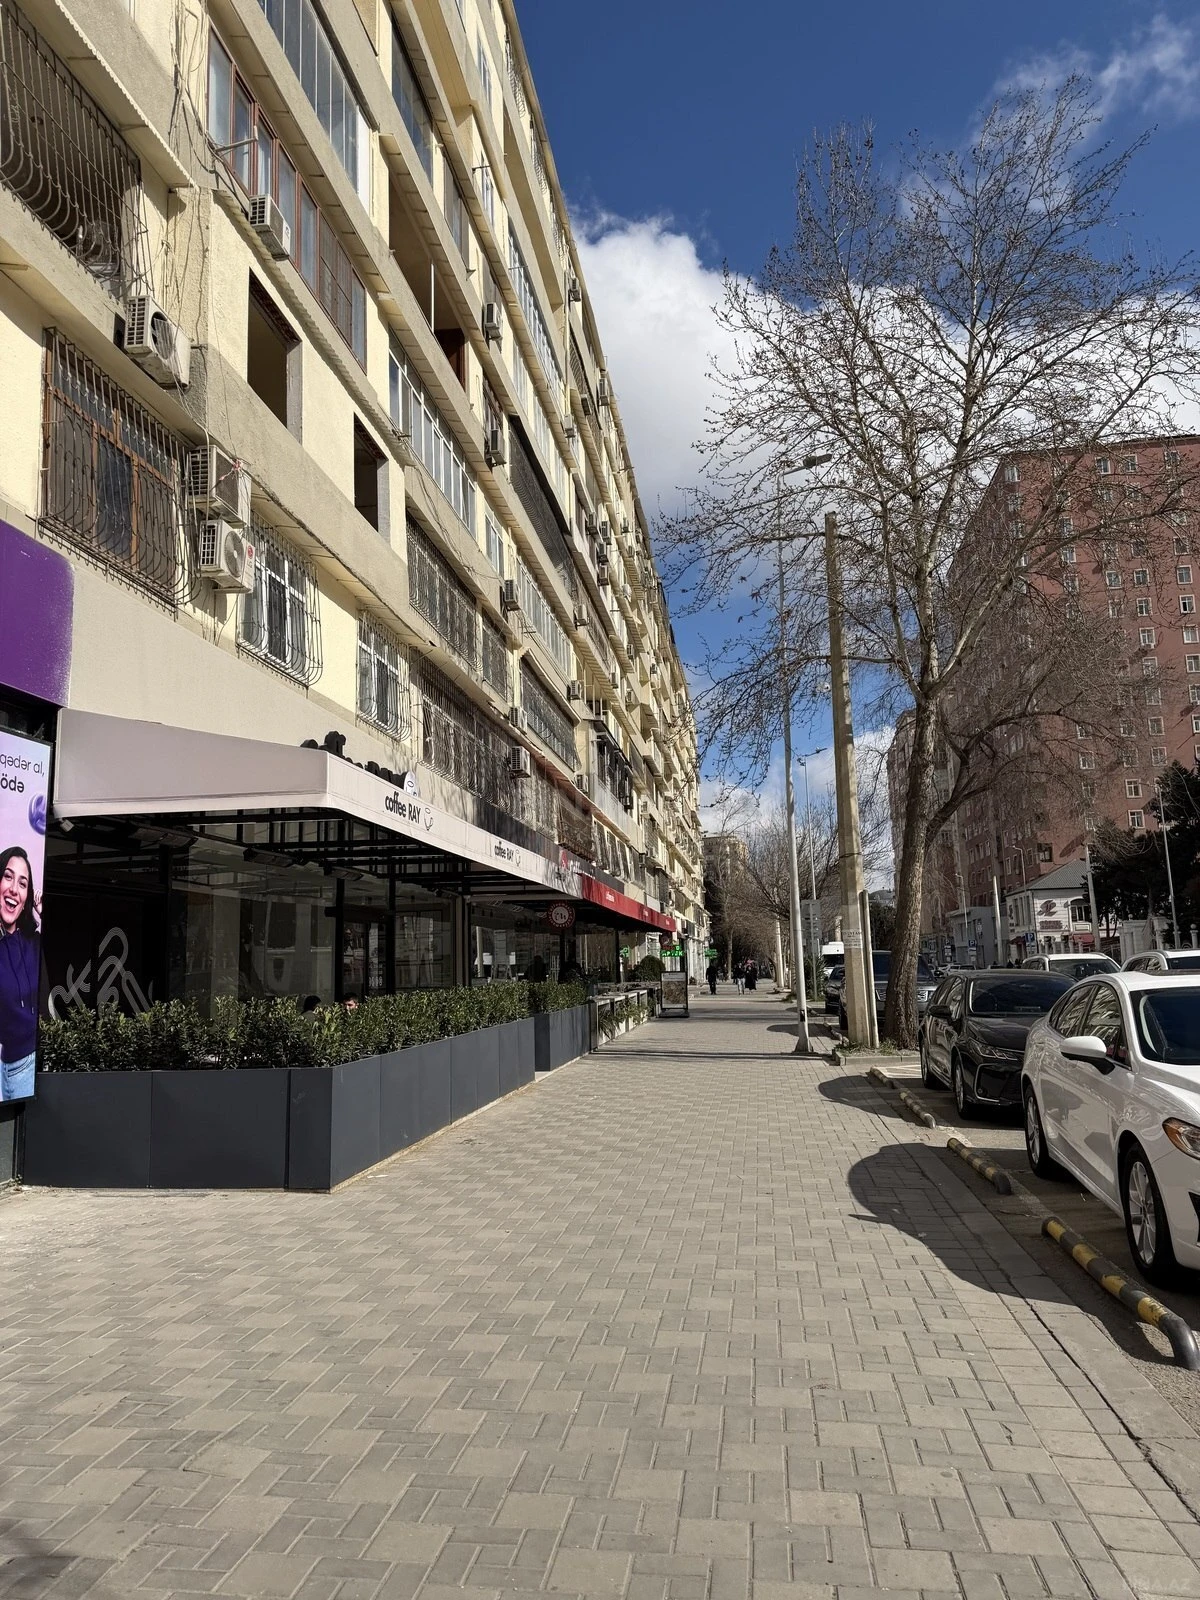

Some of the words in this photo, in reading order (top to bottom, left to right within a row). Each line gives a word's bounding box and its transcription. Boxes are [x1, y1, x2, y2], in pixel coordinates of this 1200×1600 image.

[0, 773, 25, 793] ödə
[385, 791, 407, 818] coffee
[408, 803, 421, 824] RAY
